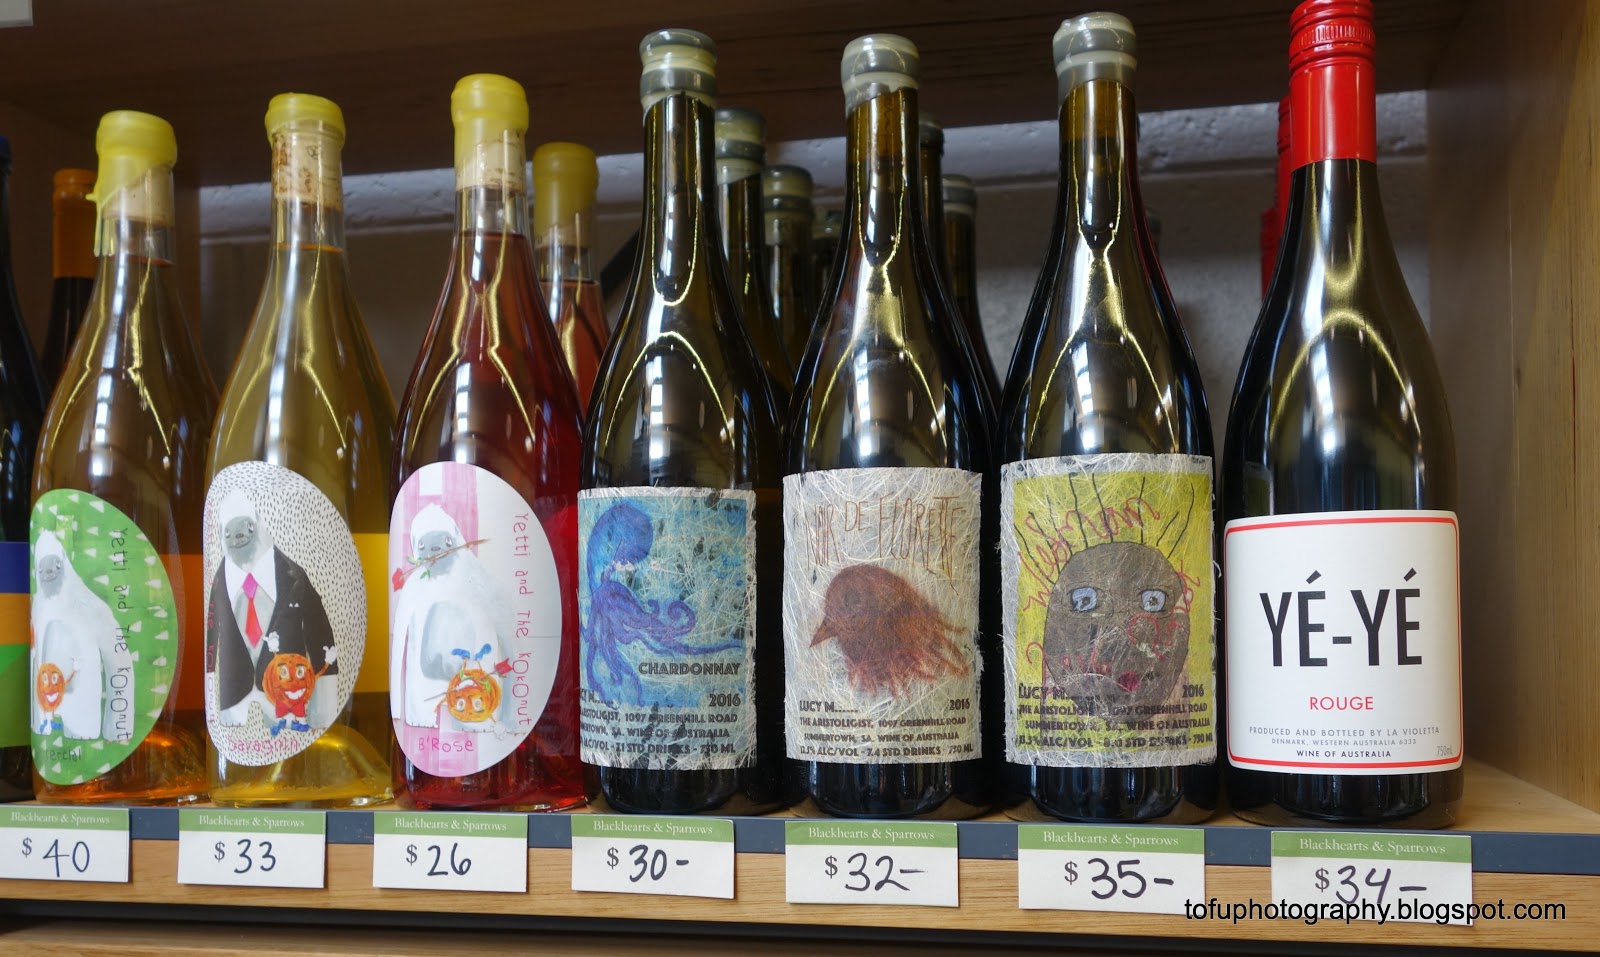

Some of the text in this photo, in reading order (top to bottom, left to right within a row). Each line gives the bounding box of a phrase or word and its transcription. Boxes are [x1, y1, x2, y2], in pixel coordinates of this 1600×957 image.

[845, 500, 871, 532] DE
[513, 512, 531, 557] Yetti
[111, 528, 130, 572] Yetti
[514, 570, 534, 595] and
[114, 585, 133, 611] and
[1259, 567, 1422, 667] YÉ-YÉ
[515, 610, 531, 639] The
[115, 625, 130, 653] The
[638, 662, 741, 675] CHARDONNAY
[1018, 685, 1048, 699] LUCY
[1183, 684, 1204, 698] 2016
[708, 693, 741, 707] 2016
[800, 700, 821, 712] LUCY
[949, 698, 970, 710] 2016
[1309, 696, 1374, 711] ROUGE
[1019, 705, 1032, 714] THE
[1135, 704, 1187, 715] GREENHILL
[1189, 703, 1208, 713] ROAD
[625, 713, 647, 722] 1097
[708, 714, 738, 722] ROAD
[800, 717, 811, 726] THE
[878, 719, 897, 727] 1097
[900, 718, 945, 727] GREENHILL
[946, 717, 966, 725] ROAD
[1127, 721, 1154, 730] WINE
[1157, 720, 1170, 729] OF
[1172, 718, 1210, 729] AUSTRALIA
[654, 729, 669, 737] OF
[672, 729, 730, 738] AUSTRALIA
[877, 734, 900, 742] WINE
[902, 733, 914, 741] OF
[917, 732, 960, 741] AUSTRALIA
[1249, 726, 1291, 735] PRODUCED
[1295, 728, 1316, 736] AND
[1321, 729, 1365, 737] BOTTLED
[1402, 726, 1440, 735] VIOLETTA
[419, 736, 474, 752] B'Rose
[627, 743, 645, 753] STD
[720, 744, 736, 753] ML
[1041, 737, 1093, 747] ALC/VOL
[1125, 737, 1146, 747] STD
[817, 747, 859, 756] ALC/VOL
[883, 748, 900, 756] STD
[903, 746, 942, 756] DRINKS
[964, 744, 973, 752] ML
[1296, 749, 1320, 757] WINE
[1341, 750, 1391, 758] AUSTRALIA
[11, 812, 110, 826] Blackhearts & Sparrows
[199, 815, 305, 829] Blackhearts & Sparrows
[395, 818, 507, 832] Blackhearts & Sparrows
[594, 820, 713, 836] Blackhearts & Sparrows
[808, 827, 935, 842] Blackhearts & Sparrows
[1043, 831, 1179, 847] Blackhearts & Sparrows
[1300, 838, 1446, 855] Blackhearts & Sparrows
